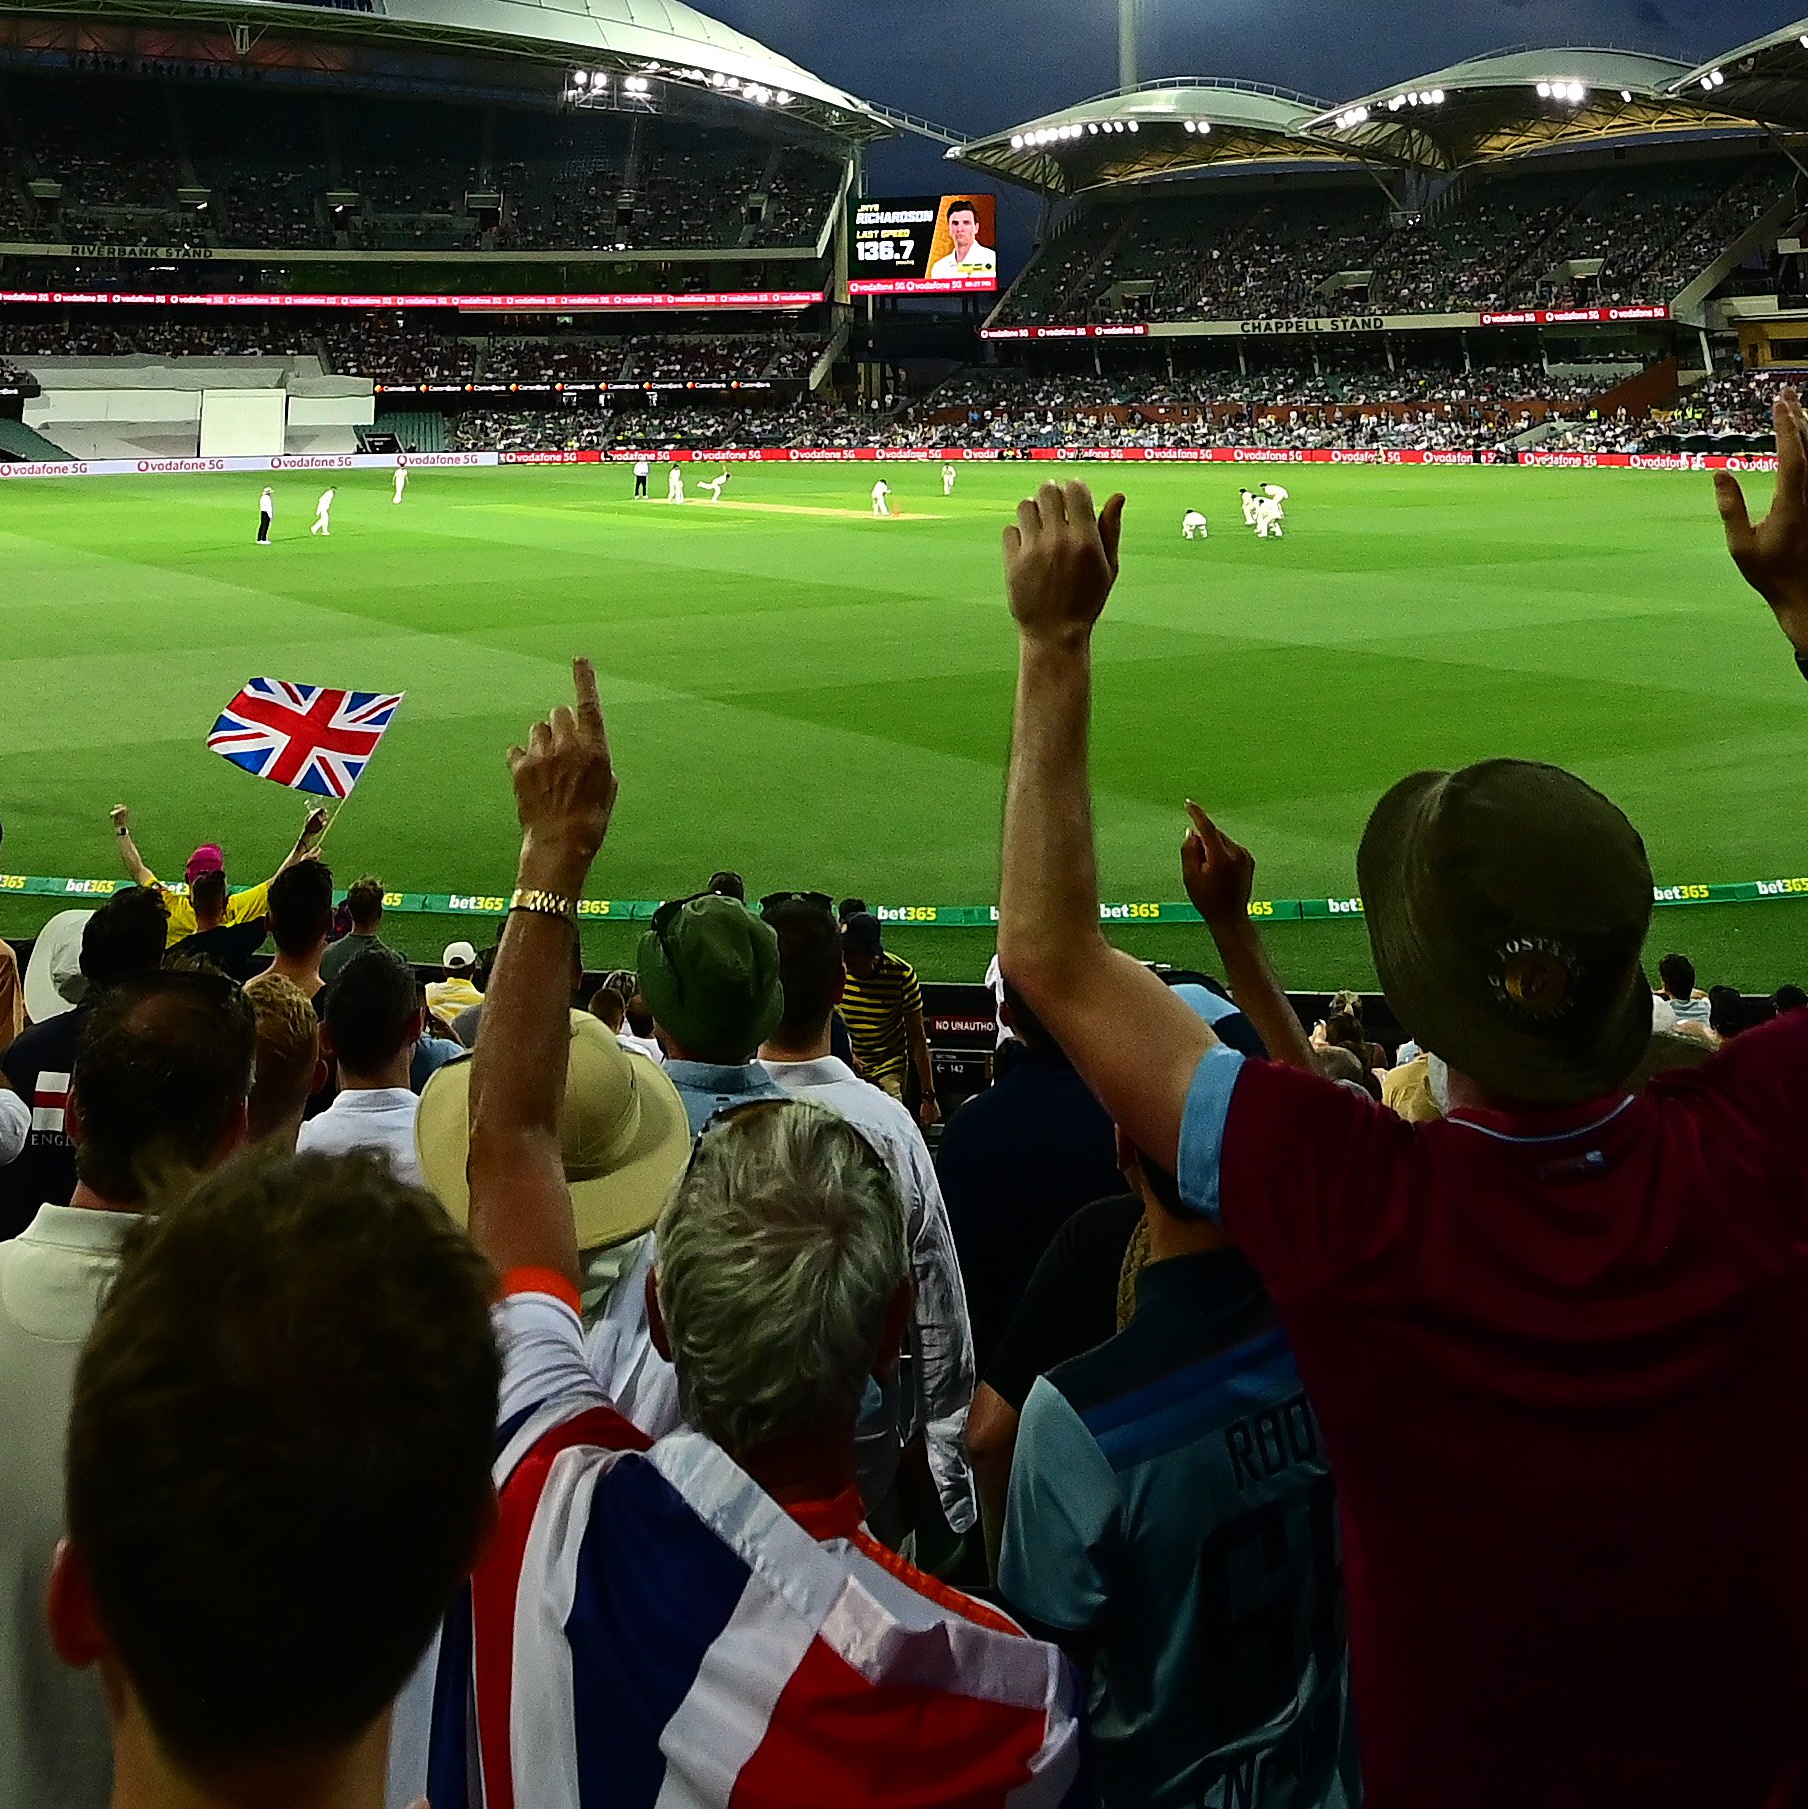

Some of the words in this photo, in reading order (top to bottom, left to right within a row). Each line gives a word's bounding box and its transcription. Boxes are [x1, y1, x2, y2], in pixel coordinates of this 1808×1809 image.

[856, 210, 934, 225] RICHARDSON
[856, 230, 879, 240] LAST
[881, 228, 911, 239] SPEED
[71, 245, 160, 258] RIVERBANK
[165, 248, 213, 259] STAND
[856, 240, 915, 261] 136.7
[857, 283, 894, 292] vodafone
[894, 281, 906, 291] 5G
[915, 281, 951, 290] vodafone
[952, 280, 963, 289] 5G
[1491, 314, 1525, 323] vodafone
[1525, 313, 1536, 322] 5G
[1554, 312, 1587, 321] vodafone
[1588, 311, 1600, 320] 5G
[1617, 309, 1653, 318] vodafone
[1654, 307, 1665, 317] 5G
[1240, 319, 1327, 333] CHAPPELL
[1331, 317, 1384, 331] STAND
[408, 455, 461, 465] vodafone
[463, 454, 478, 464] 5G
[516, 451, 561, 462] vodafone
[563, 451, 577, 462] 5G
[611, 451, 655, 461] vodafone
[656, 450, 670, 460] 5G
[701, 450, 747, 460] vodafone
[748, 450, 762, 460] 5G
[798, 449, 842, 459] vodafone
[842, 449, 856, 459] 5G
[884, 448, 928, 459] vodafone
[928, 448, 942, 459] 5G
[1110, 449, 1124, 459] 5G
[1153, 449, 1198, 460] vodafone
[1199, 448, 1213, 460] 5G
[1243, 449, 1288, 461] vodafone
[1288, 450, 1303, 461] 5G
[1387, 451, 1401, 461] 5G
[1535, 453, 1582, 466] vodafone
[1583, 454, 1597, 466] 5G
[150, 460, 206, 471] vodafone
[208, 459, 224, 470] 5G
[280, 457, 335, 468] vodafone
[337, 456, 352, 467] 5G
[12, 464, 69, 476] vodafone
[71, 462, 88, 474] 5G
[65, 878, 116, 893] bet365
[1653, 884, 1709, 901] bet365
[449, 894, 505, 911] bet365
[877, 905, 937, 921] bet365
[1100, 902, 1160, 918] bet365
[935, 1020, 950, 1031] NO
[950, 1020, 996, 1032] UNAUTHO
[950, 1064, 964, 1073] 142
[1225, 1396, 1317, 1490] ROO
